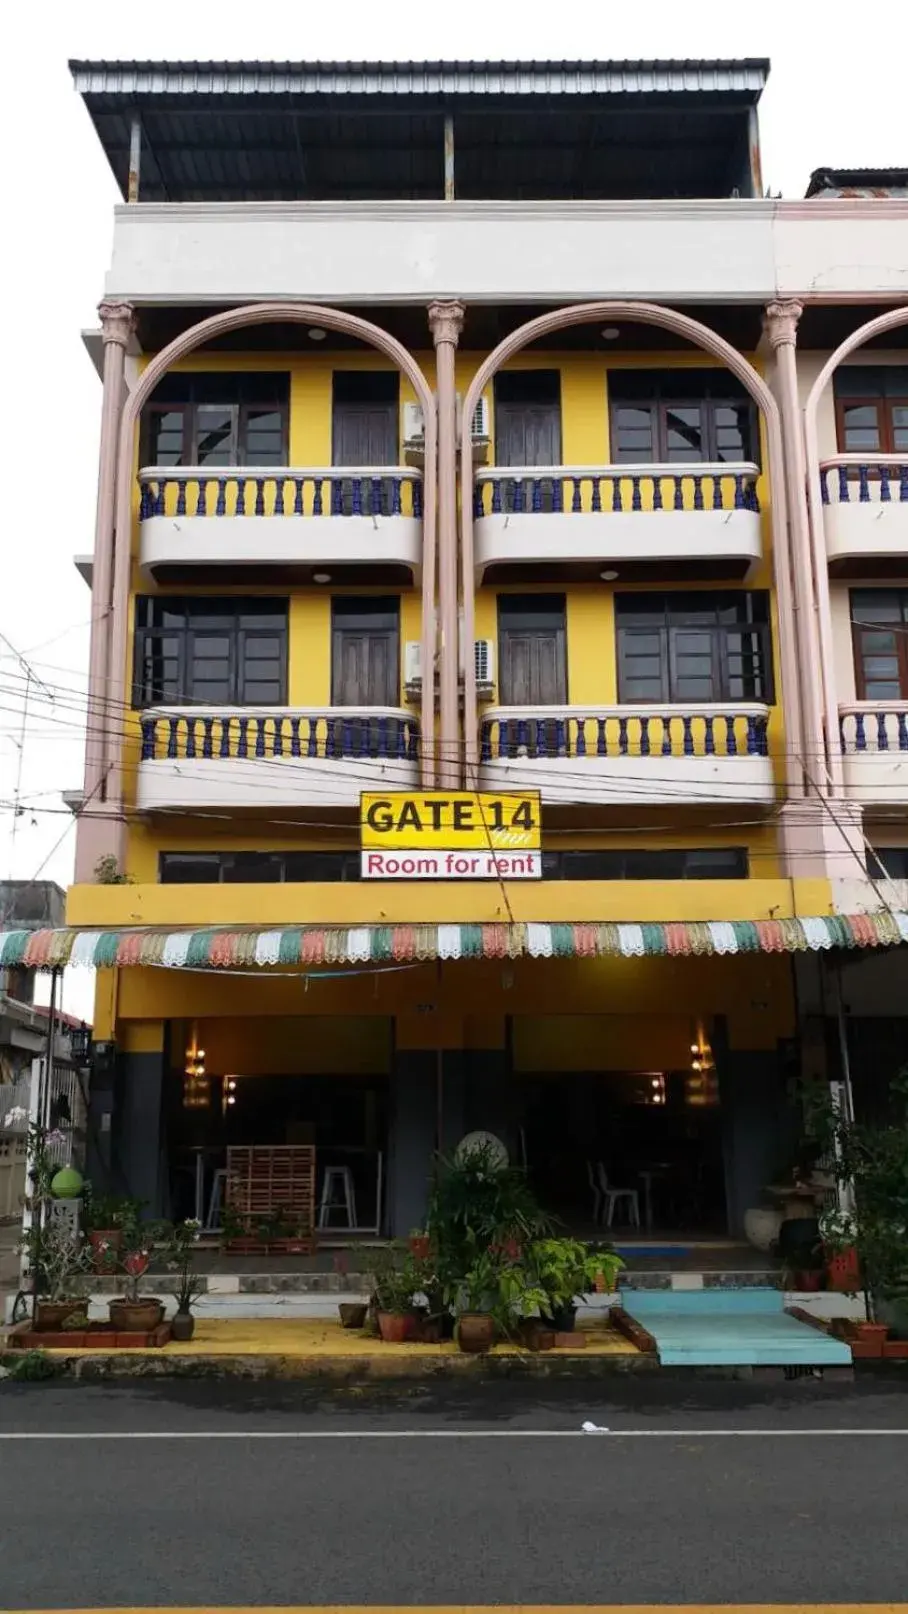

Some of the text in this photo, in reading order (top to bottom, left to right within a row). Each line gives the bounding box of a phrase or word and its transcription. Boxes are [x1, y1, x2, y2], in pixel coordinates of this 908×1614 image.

[367, 801, 535, 832] GATE 14
[368, 854, 534, 874] Room for rent
